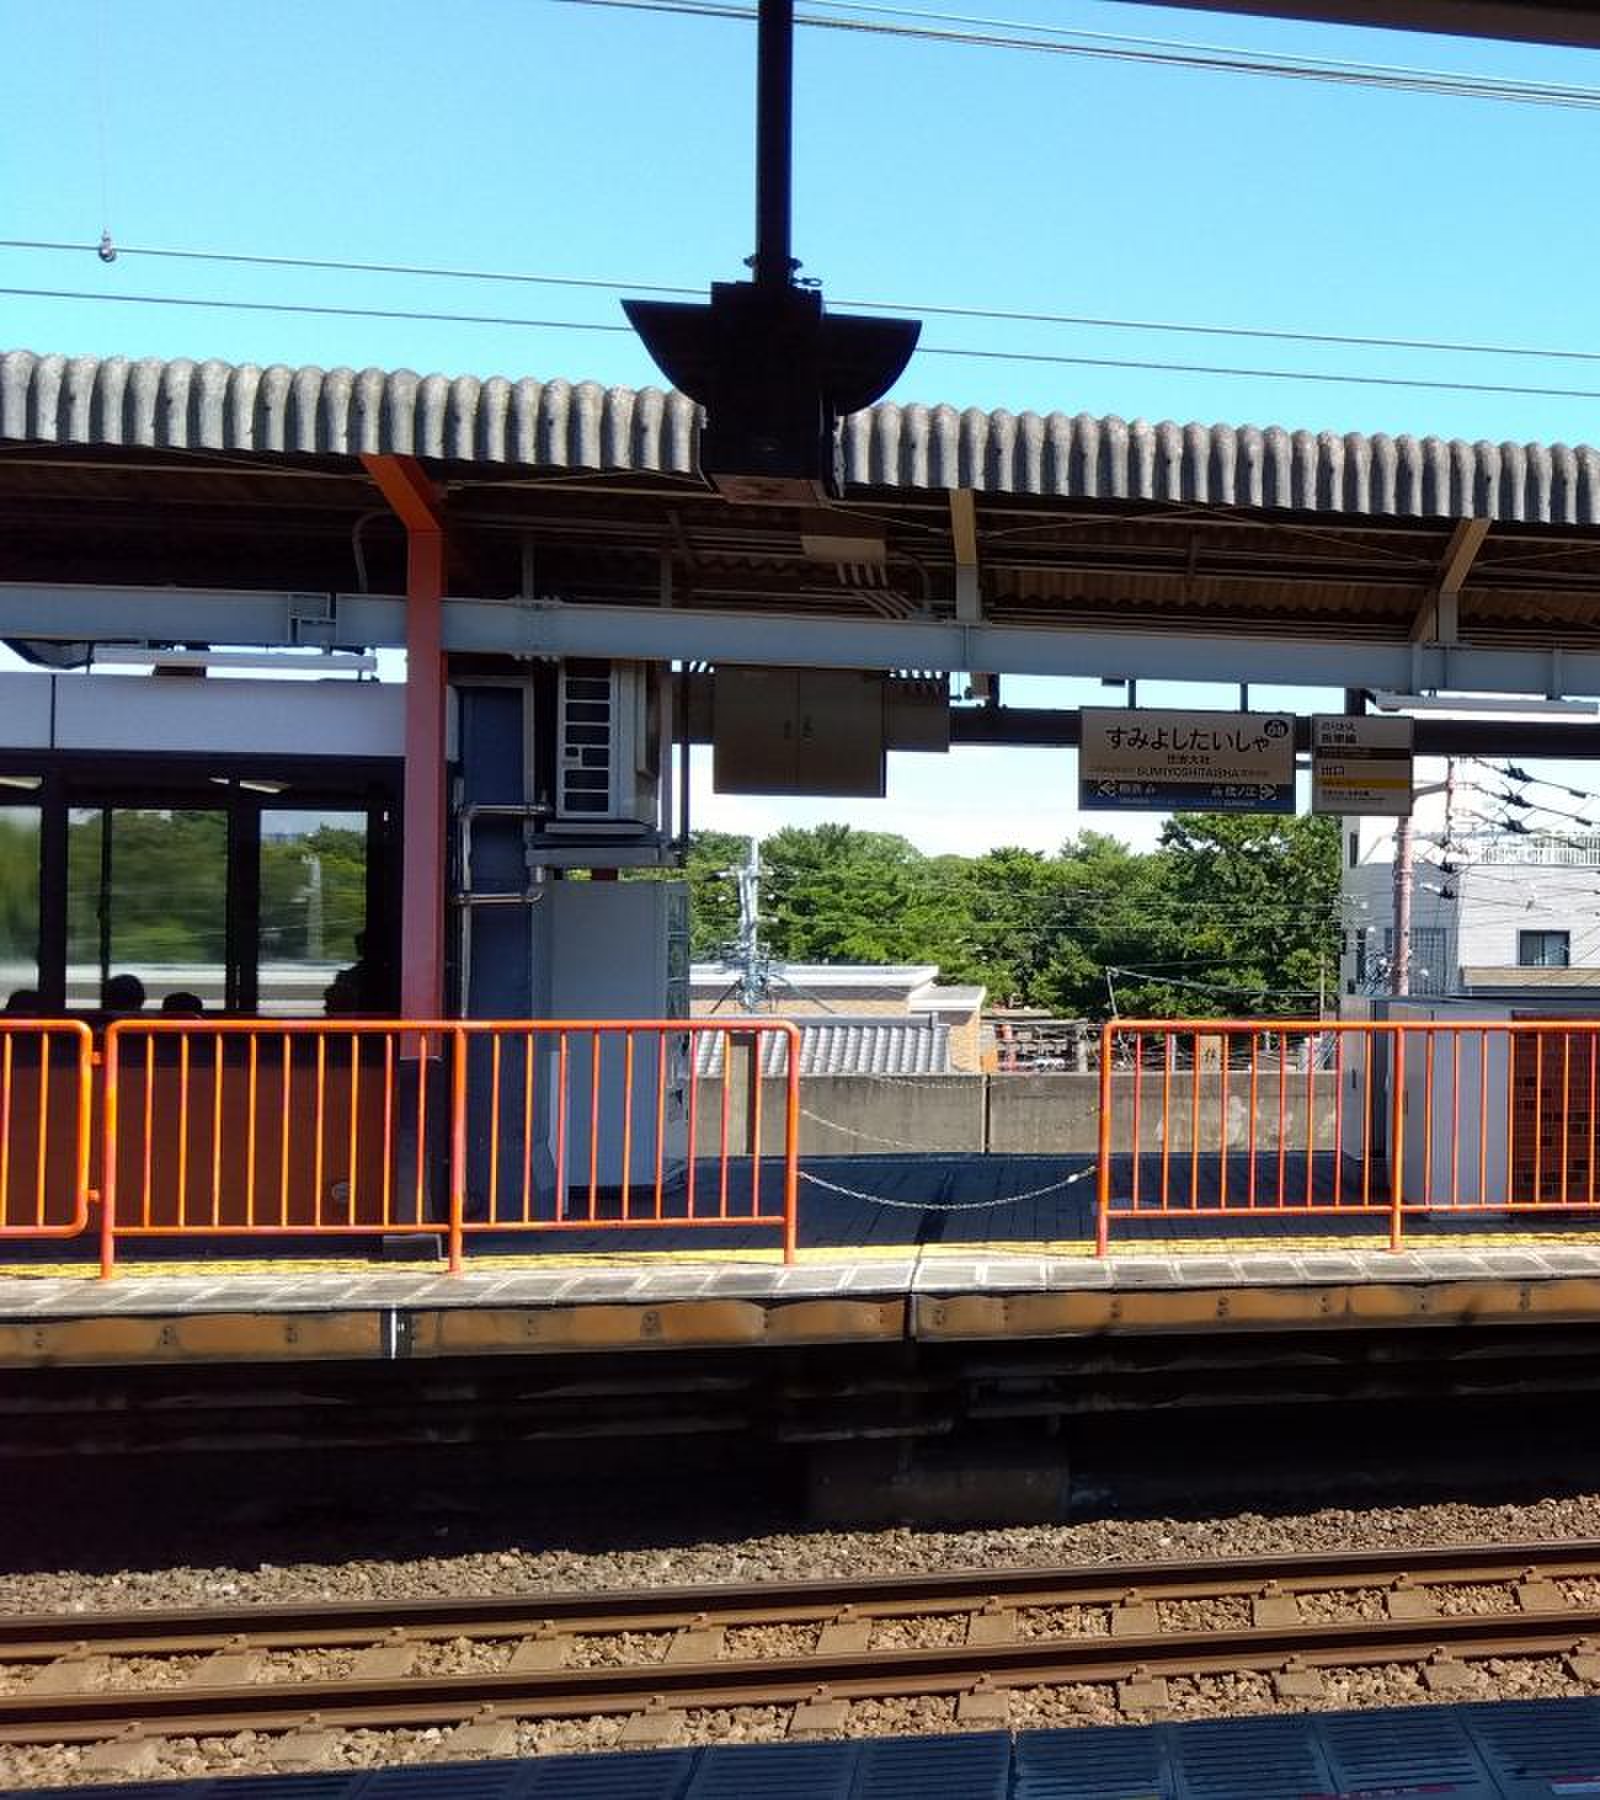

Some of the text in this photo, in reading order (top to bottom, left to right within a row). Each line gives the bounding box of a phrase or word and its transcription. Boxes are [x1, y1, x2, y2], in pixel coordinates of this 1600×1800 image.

[1105, 726, 1270, 752] すみよしたいしゃ
